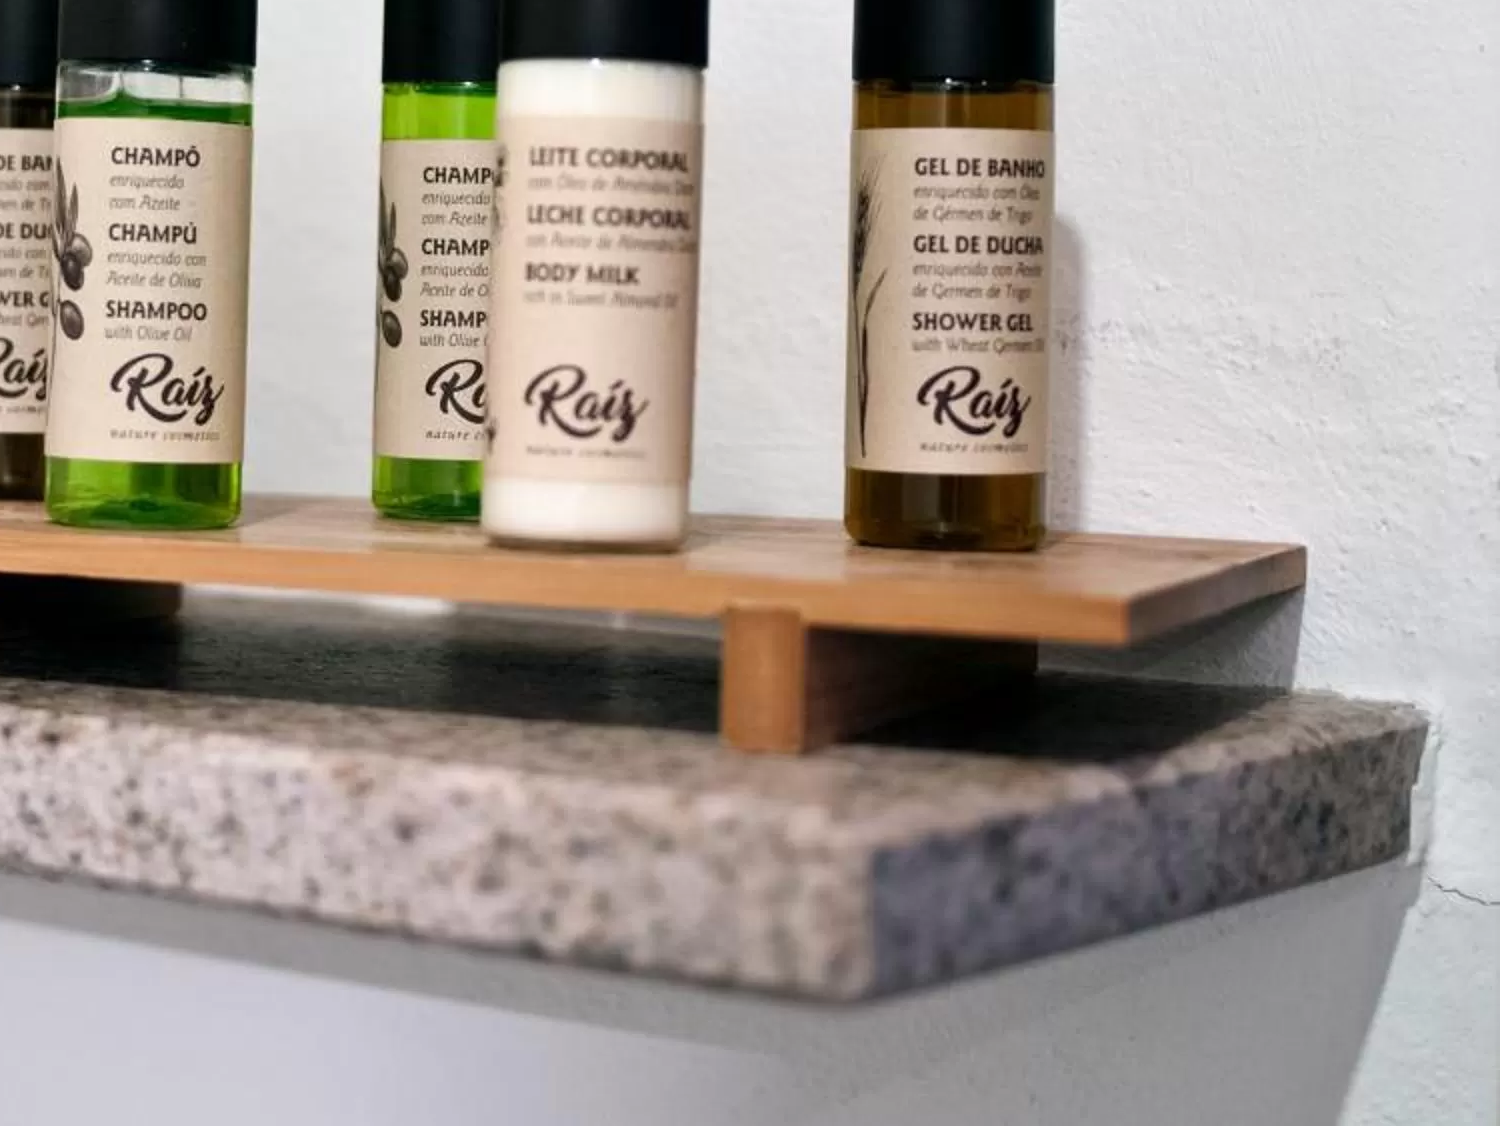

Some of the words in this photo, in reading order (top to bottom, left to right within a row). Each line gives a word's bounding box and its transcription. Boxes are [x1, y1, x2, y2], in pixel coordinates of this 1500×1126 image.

[22, 155, 53, 171] BAN
[529, 147, 579, 167] LEITE
[586, 148, 688, 172] CORPORAL
[915, 158, 950, 176] GEL
[957, 159, 981, 176] DE
[988, 159, 1045, 178] BANHO
[423, 166, 494, 184] CHAMP
[528, 205, 584, 225] LECHE
[422, 238, 490, 256] CHAMP
[914, 235, 949, 253] GEL
[955, 236, 980, 253] DE
[987, 236, 1043, 254] DUCHA
[150, 273, 165, 287] de
[525, 262, 579, 281] BODY
[587, 265, 639, 284] MILK
[460, 283, 474, 297] de
[106, 299, 207, 321] SHAMPOO
[420, 309, 487, 328] SHAMP
[913, 313, 1002, 331] SHOWER
[1008, 314, 1033, 331] GEL
